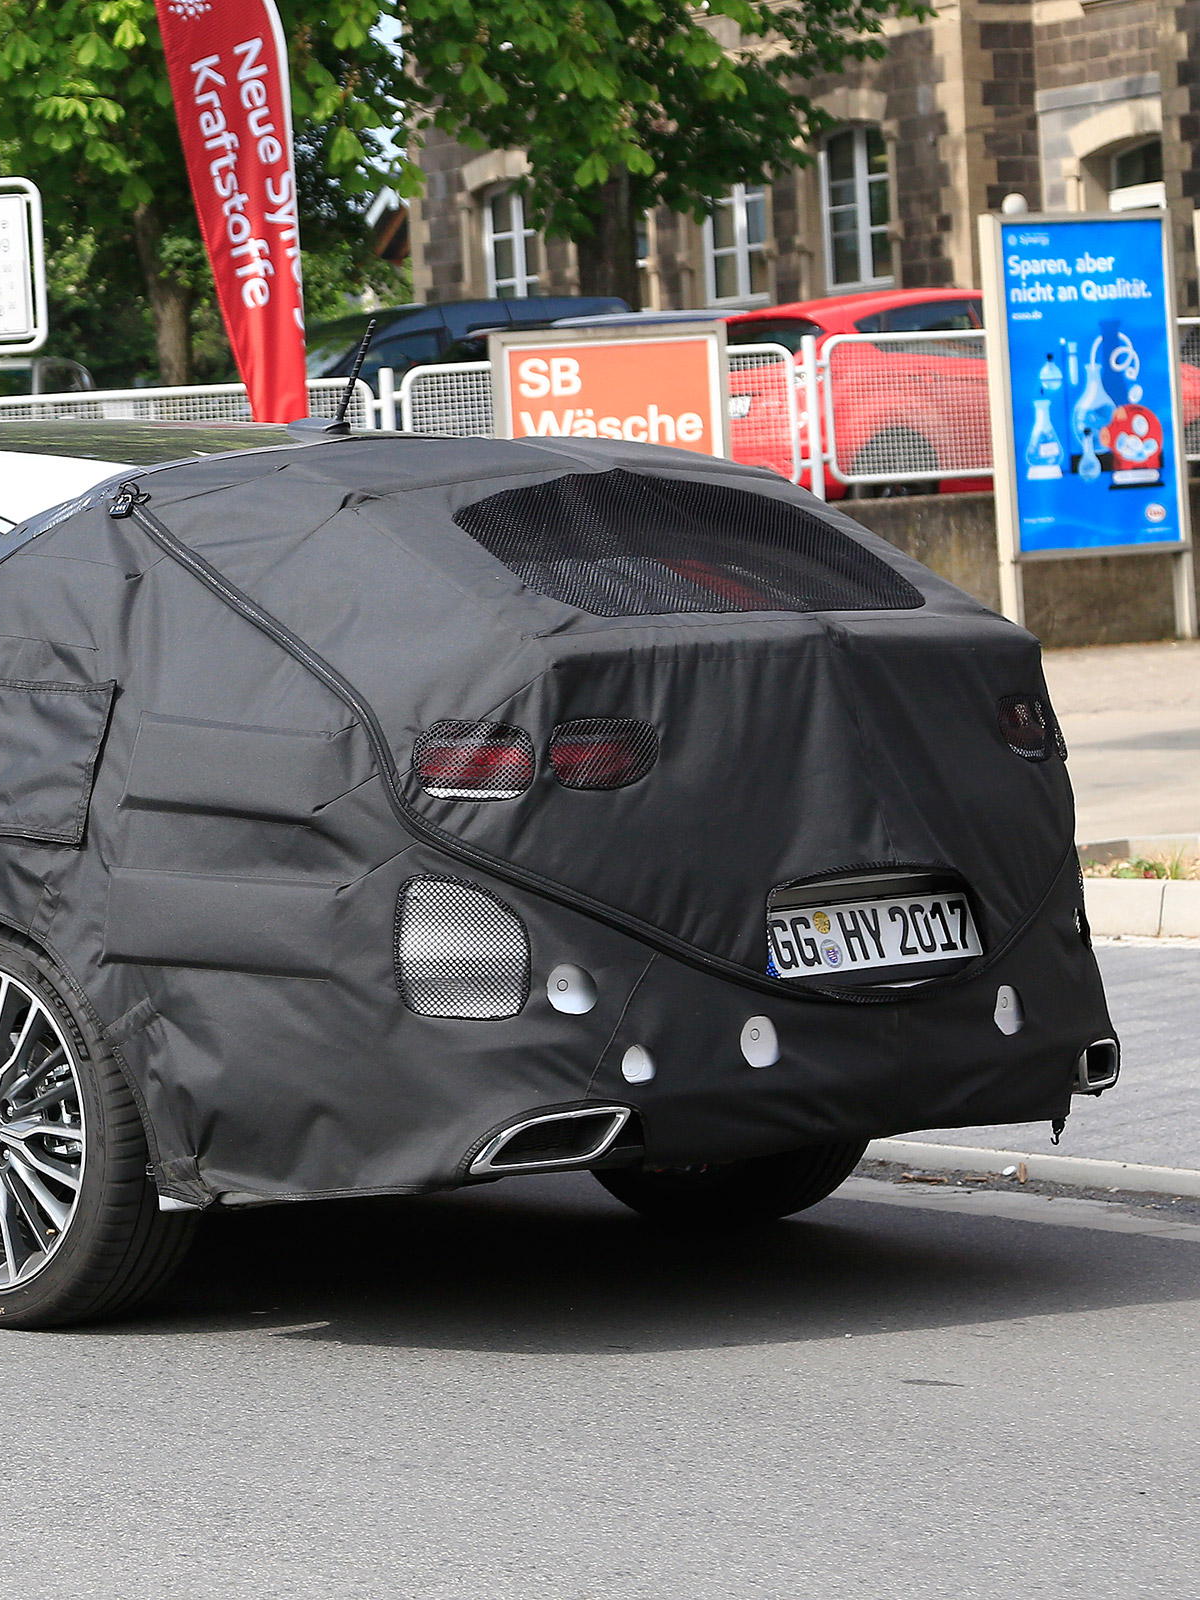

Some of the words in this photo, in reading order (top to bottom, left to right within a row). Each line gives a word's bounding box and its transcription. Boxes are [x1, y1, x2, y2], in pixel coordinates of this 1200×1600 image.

[233, 37, 284, 165] Neue
[190, 54, 275, 309] Kraftstoffe
[1007, 254, 1072, 280] Sparen,
[1075, 251, 1115, 274] aber
[1010, 281, 1055, 303] nicht
[1057, 285, 1079, 302] an
[1081, 278, 1152, 302] Qualität.
[518, 357, 582, 398] SB
[519, 404, 704, 443] Wäsche
[768, 917, 823, 970] GG
[836, 908, 886, 962] HY
[888, 900, 969, 956] 2017
